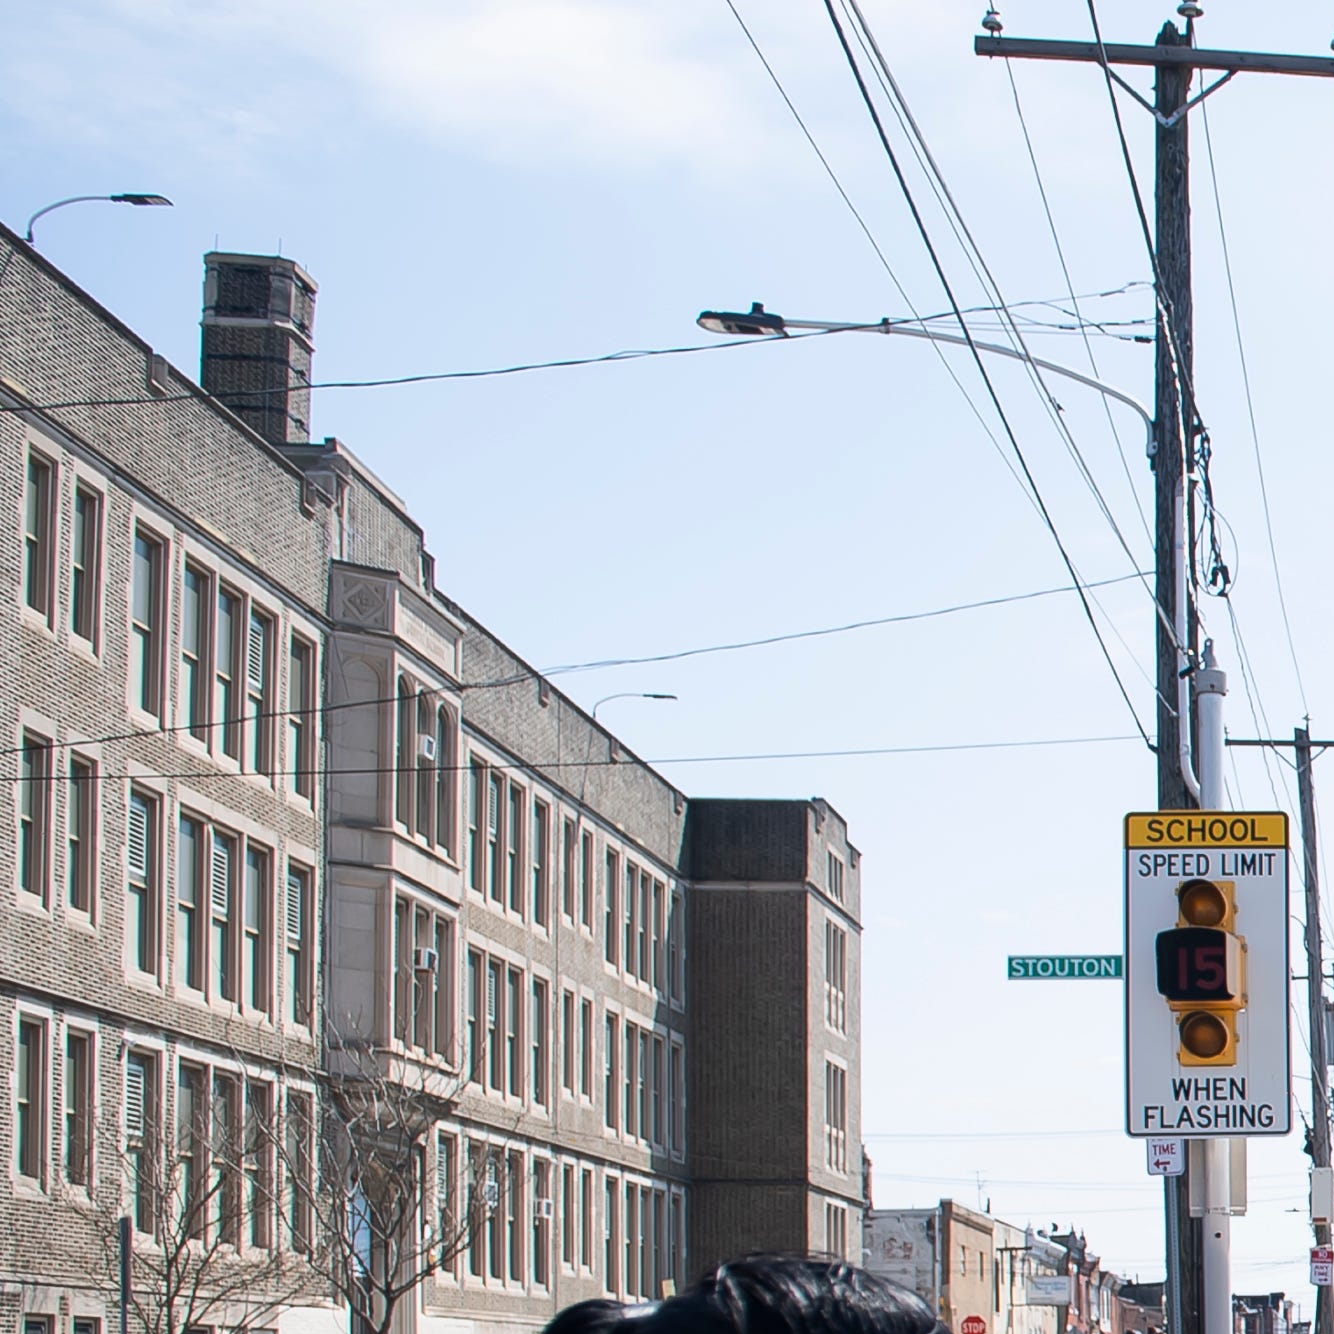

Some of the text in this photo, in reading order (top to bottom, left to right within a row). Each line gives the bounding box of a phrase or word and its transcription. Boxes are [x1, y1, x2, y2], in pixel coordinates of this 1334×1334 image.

[1146, 818, 1268, 843] SCHOOL
[1138, 852, 1276, 878] SPEED LIMIT
[1011, 957, 1116, 977] STOUTON
[1177, 946, 1226, 991] 15
[1172, 1077, 1247, 1101] WHEN
[1143, 1104, 1275, 1129] FLASHING
[1152, 1143, 1177, 1156] TIME
[962, 1321, 986, 1334] STOP
